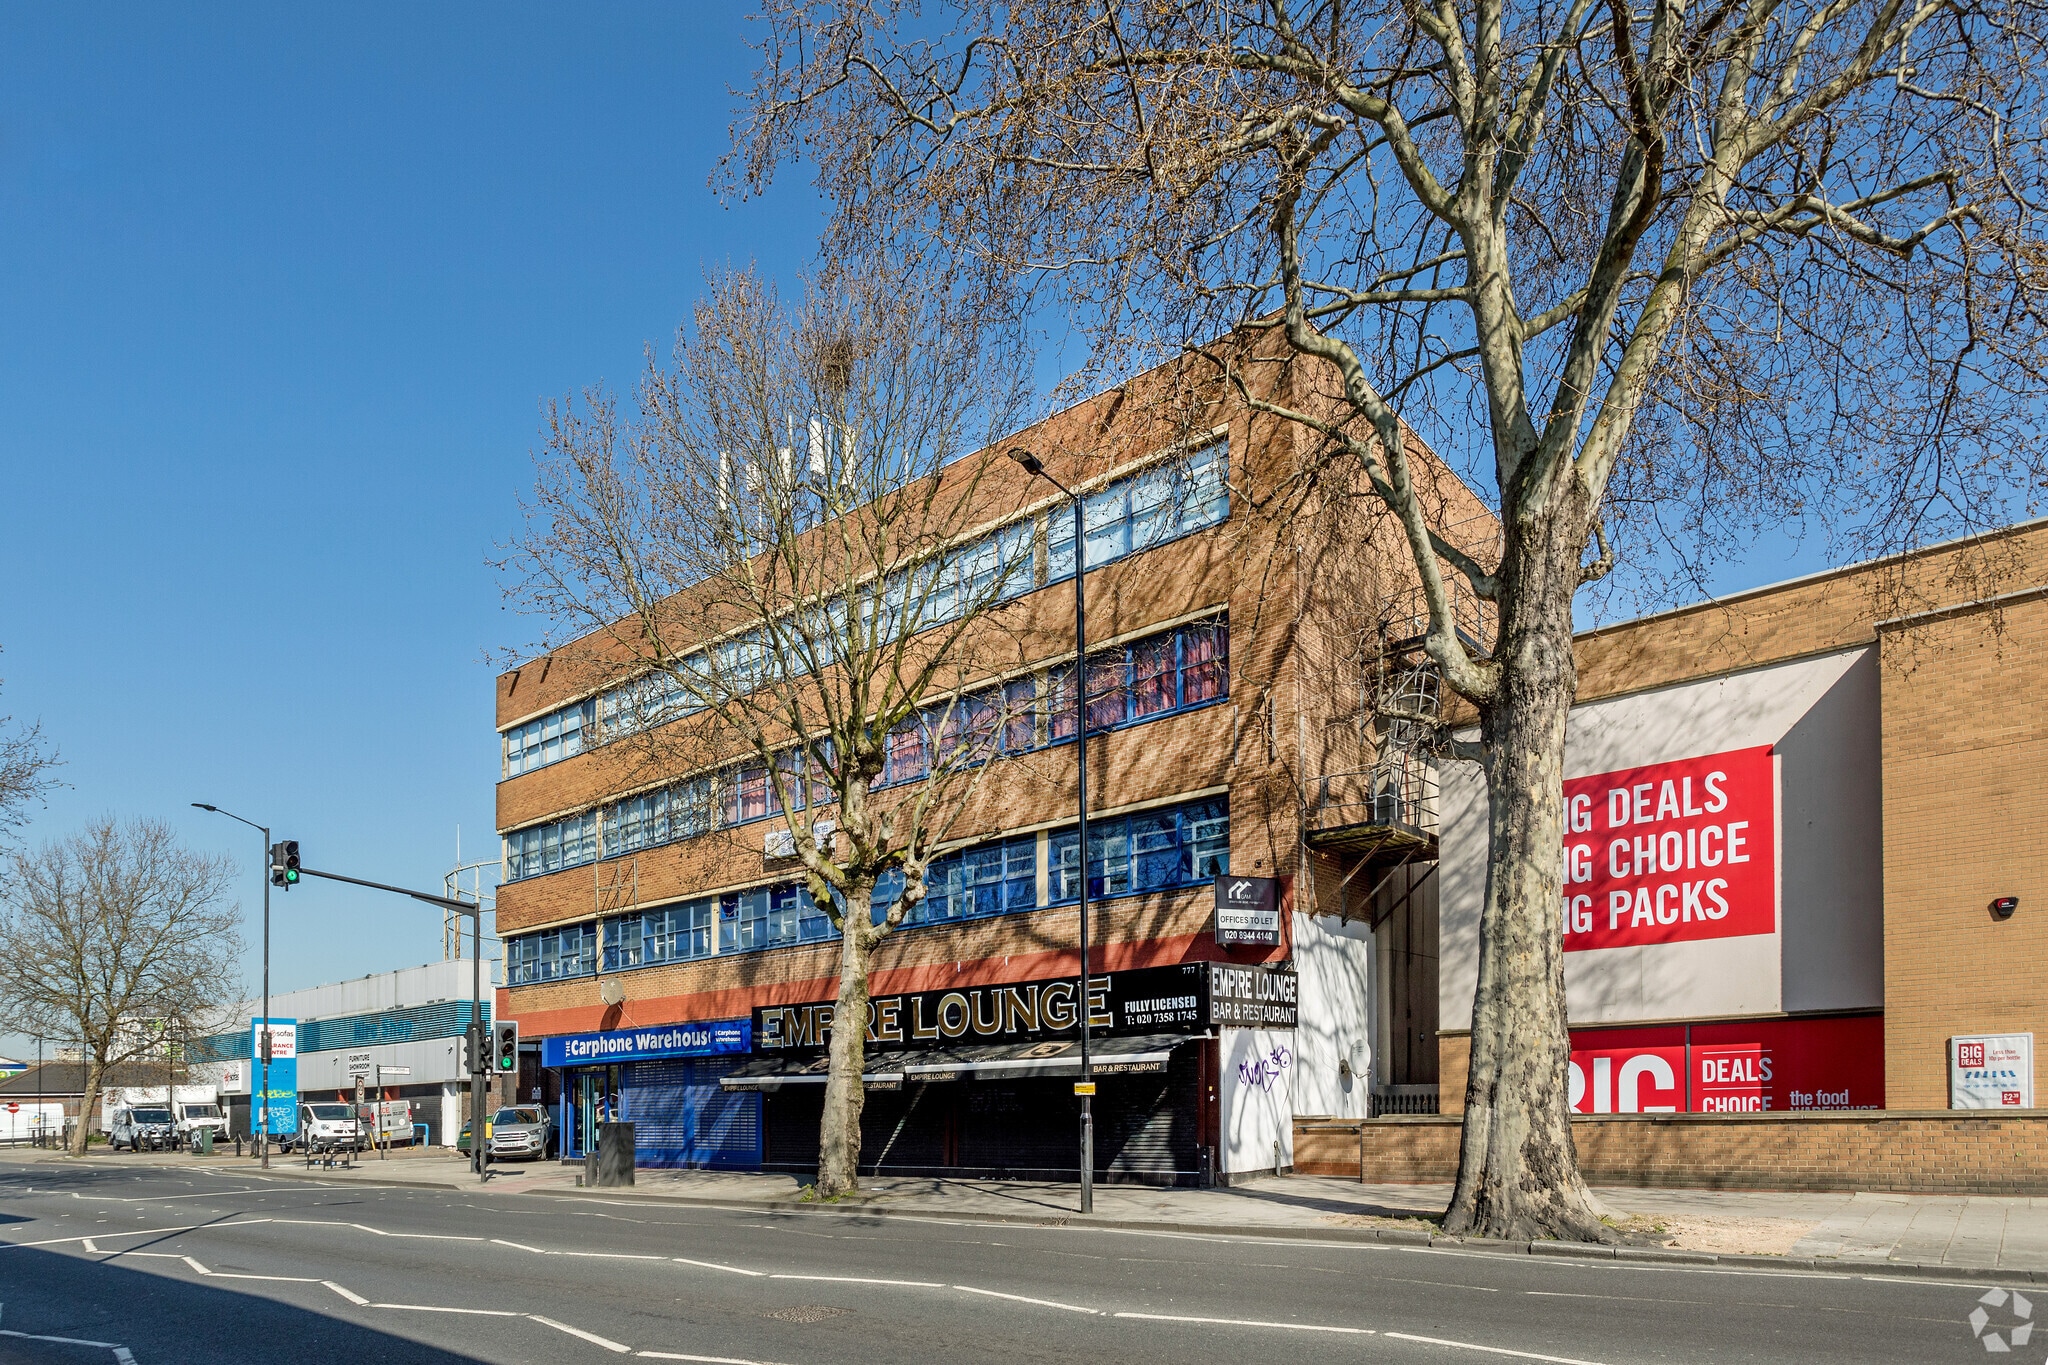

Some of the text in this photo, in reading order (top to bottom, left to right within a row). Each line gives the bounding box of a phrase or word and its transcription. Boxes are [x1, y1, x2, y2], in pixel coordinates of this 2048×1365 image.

[1563, 771, 1728, 834] IG DEALS
[1563, 821, 1750, 884] IG CHOICE
[1563, 878, 1729, 934] IG PACKS
[1224, 930, 1272, 940] 020 8944 4140
[1182, 966, 1196, 974] 777
[1212, 967, 1296, 1003] EMPIRE LOUNGE
[912, 976, 1114, 1039] LOUNGE
[1125, 996, 1196, 1014] FULLY LICENSED
[1213, 1002, 1296, 1024] BAR & RESTAURANT
[1126, 1010, 1197, 1024] T: 020 7358 1745
[571, 1029, 710, 1057] Carphone Warehous
[1960, 1046, 1982, 1058] BIG
[349, 1054, 370, 1062] FURNITURE
[1114, 1063, 1160, 1072] RESTAURANT
[1702, 1058, 1772, 1082] DEALS
[1569, 1054, 1676, 1112] IG
[1790, 1089, 1848, 1106] the food
